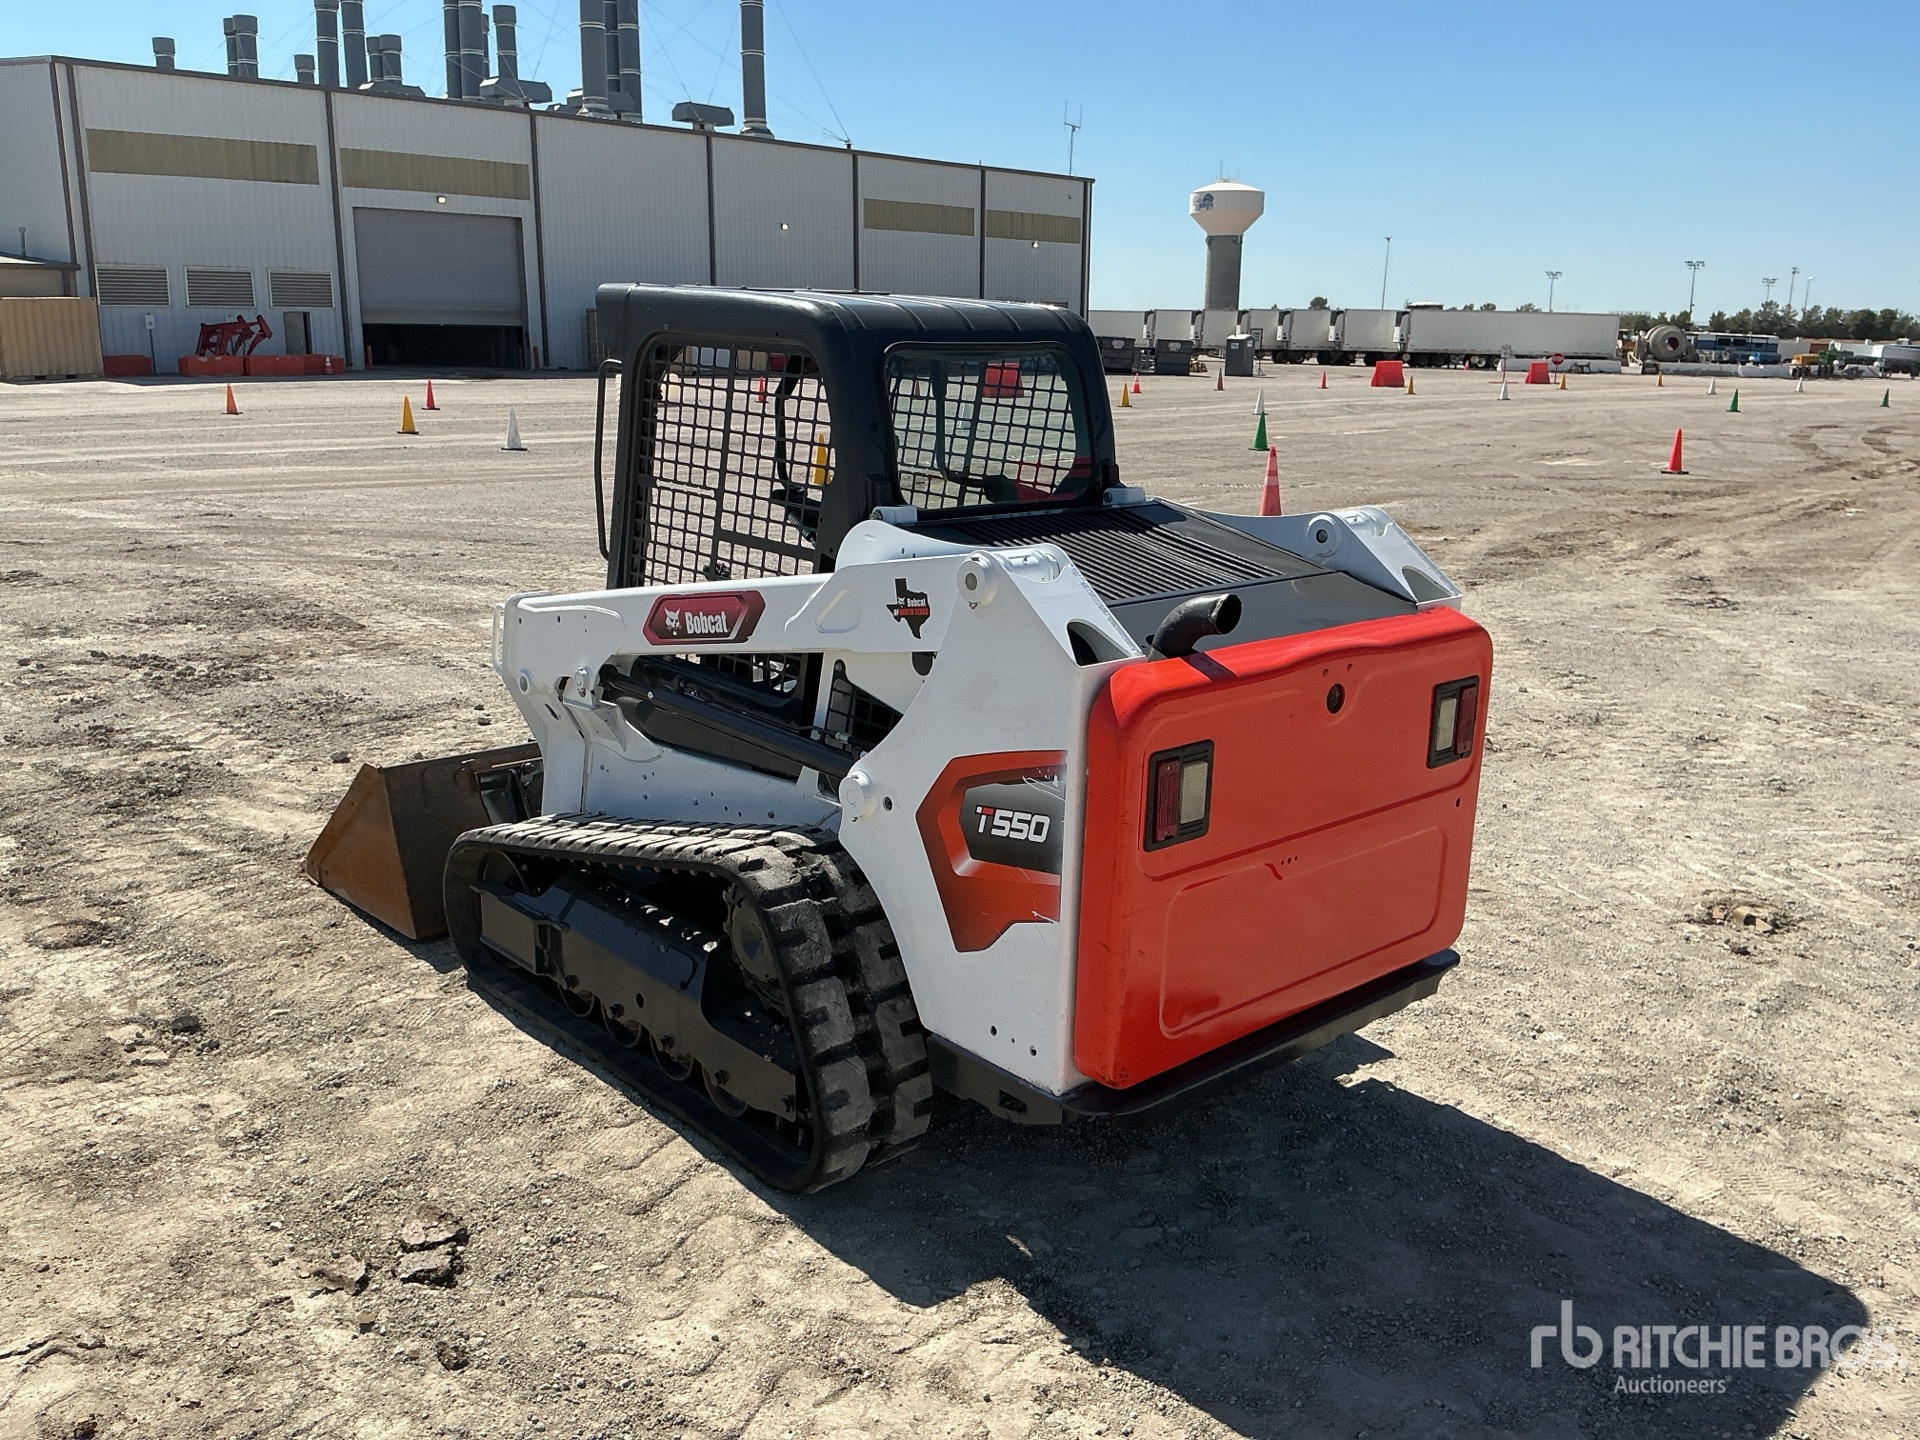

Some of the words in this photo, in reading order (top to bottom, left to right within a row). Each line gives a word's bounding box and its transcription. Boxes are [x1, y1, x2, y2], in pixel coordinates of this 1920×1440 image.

[907, 598, 926, 607] Bobcat
[684, 611, 729, 634] Bobcat
[976, 805, 1051, 843] T550
